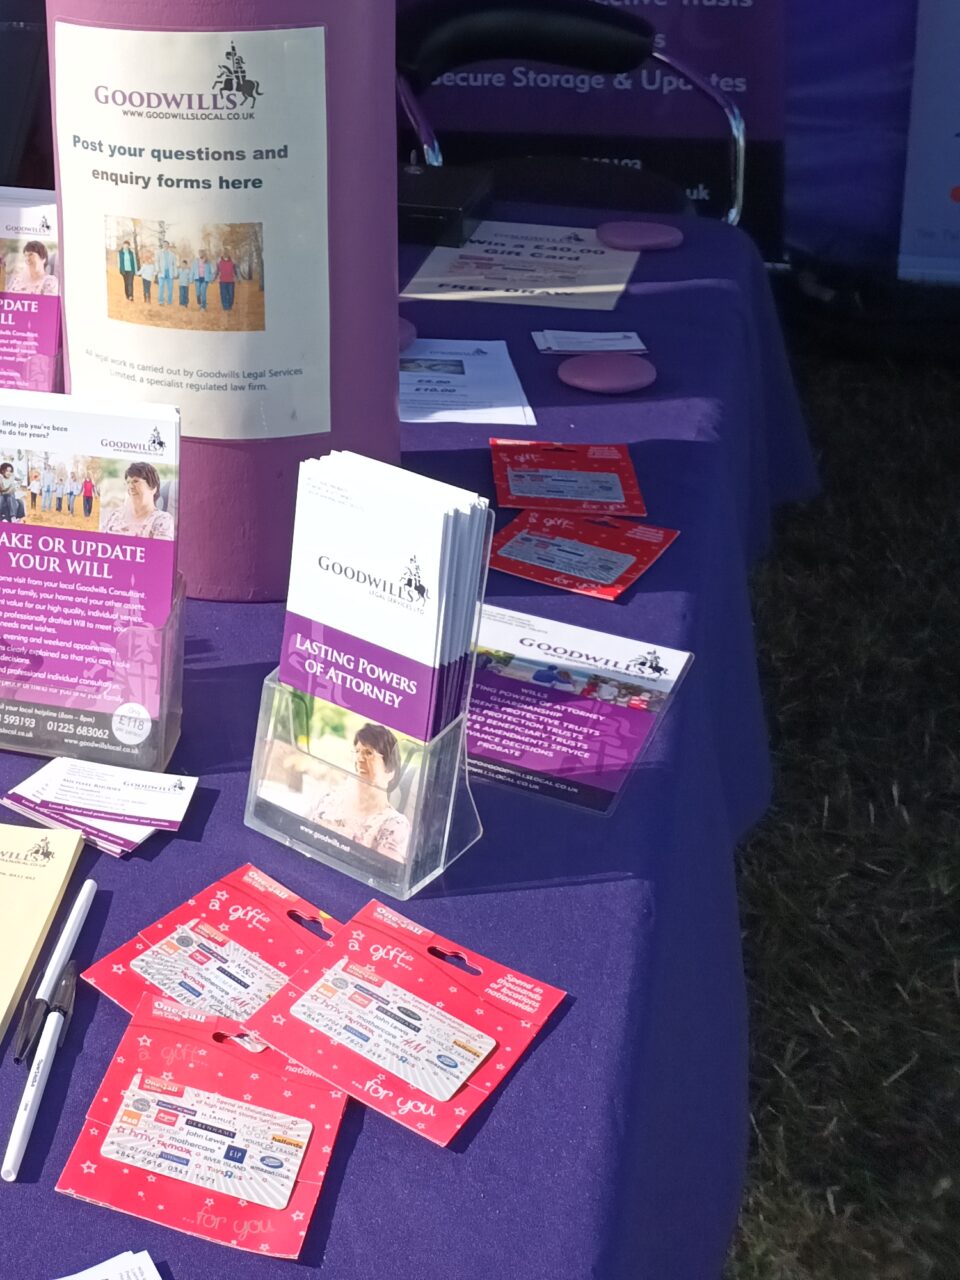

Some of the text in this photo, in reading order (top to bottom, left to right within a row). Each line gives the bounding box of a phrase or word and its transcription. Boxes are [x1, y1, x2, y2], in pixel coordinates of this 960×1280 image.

[513, 67, 604, 93] Storage
[613, 73, 632, 91] &
[641, 70, 747, 95] Uptes
[94, 85, 237, 110] GOODWILLS
[72, 134, 288, 162] Post your questions and
[91, 167, 263, 189] enquiry forms here
[137, 363, 303, 380] carried out by Goodwills Legal Services
[146, 375, 183, 390] specialist
[186, 380, 228, 393] regulated
[230, 382, 246, 392] law
[100, 438, 158, 452] GOODWILLS
[38, 536, 65, 554] OR
[72, 539, 146, 563] UPDATE
[8, 551, 113, 579] YOUR WILL
[318, 555, 414, 603] GOODWILLS
[519, 637, 647, 675] GOODWILLS
[304, 659, 403, 708] OF ATTORNEY
[358, 657, 417, 695] POWERS
[499, 689, 606, 721] POWERS ATTORNEY
[4, 714, 36, 728] 593193
[47, 721, 74, 735] 01225
[76, 725, 109, 739] 683062
[482, 710, 584, 740] PROTECTION TRUSTS
[501, 707, 601, 736] PROTECTIVE TRUSTS
[477, 740, 521, 757] PROBATE
[502, 738, 554, 758] DECISIONS
[551, 735, 589, 750] TRUSTS
[551, 743, 591, 758] SERVICE
[129, 1128, 154, 1142] hmv
[186, 1129, 226, 1146] John Lewis
[187, 1120, 234, 1138] DEBENHAMS
[169, 1135, 215, 1153] mothercare
